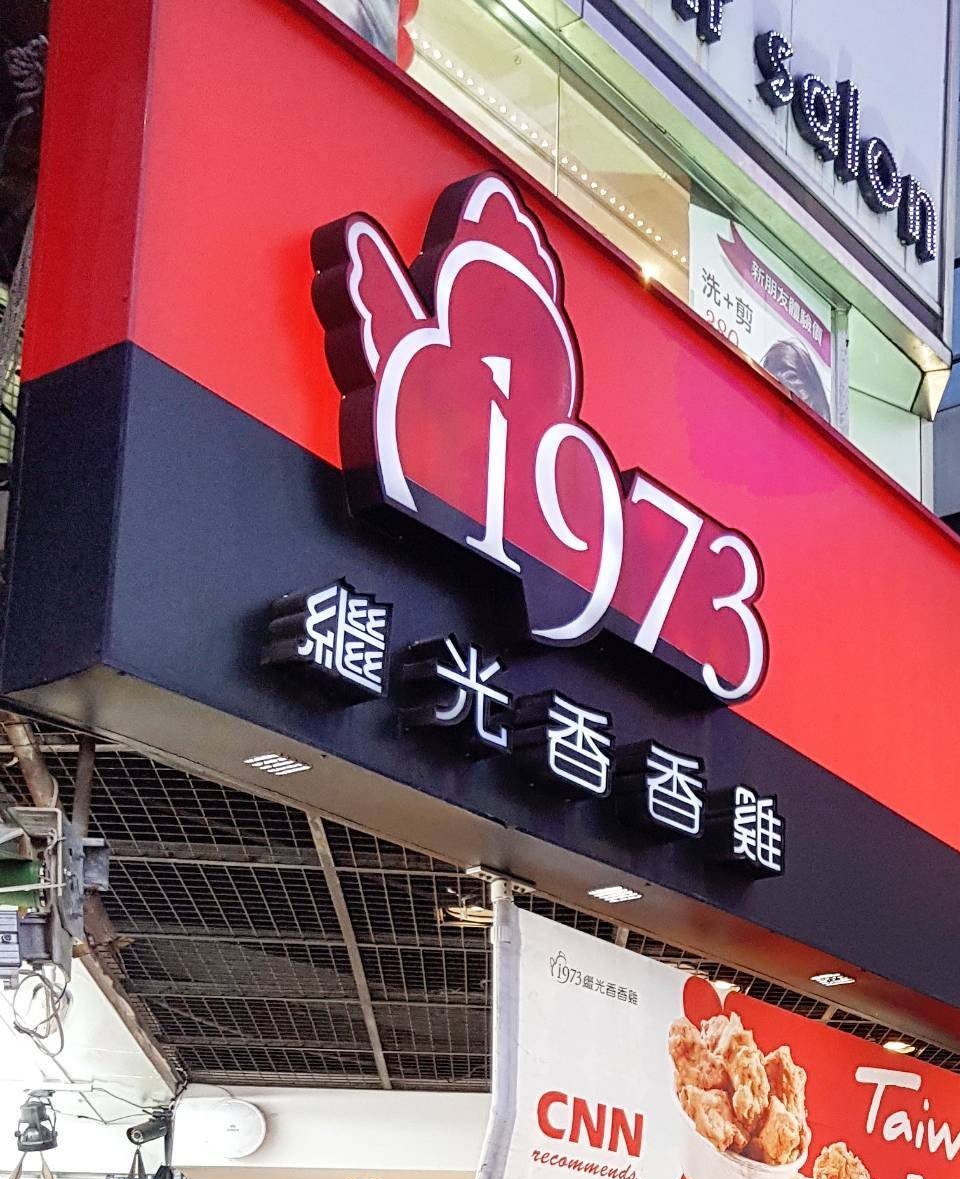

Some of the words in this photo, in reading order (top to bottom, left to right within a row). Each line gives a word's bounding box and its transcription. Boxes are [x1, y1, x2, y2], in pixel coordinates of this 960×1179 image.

[755, 30, 937, 263] salon
[466, 356, 765, 700] 1973
[297, 582, 787, 874] 繼光香香雞
[537, 1090, 644, 1157] CNN
